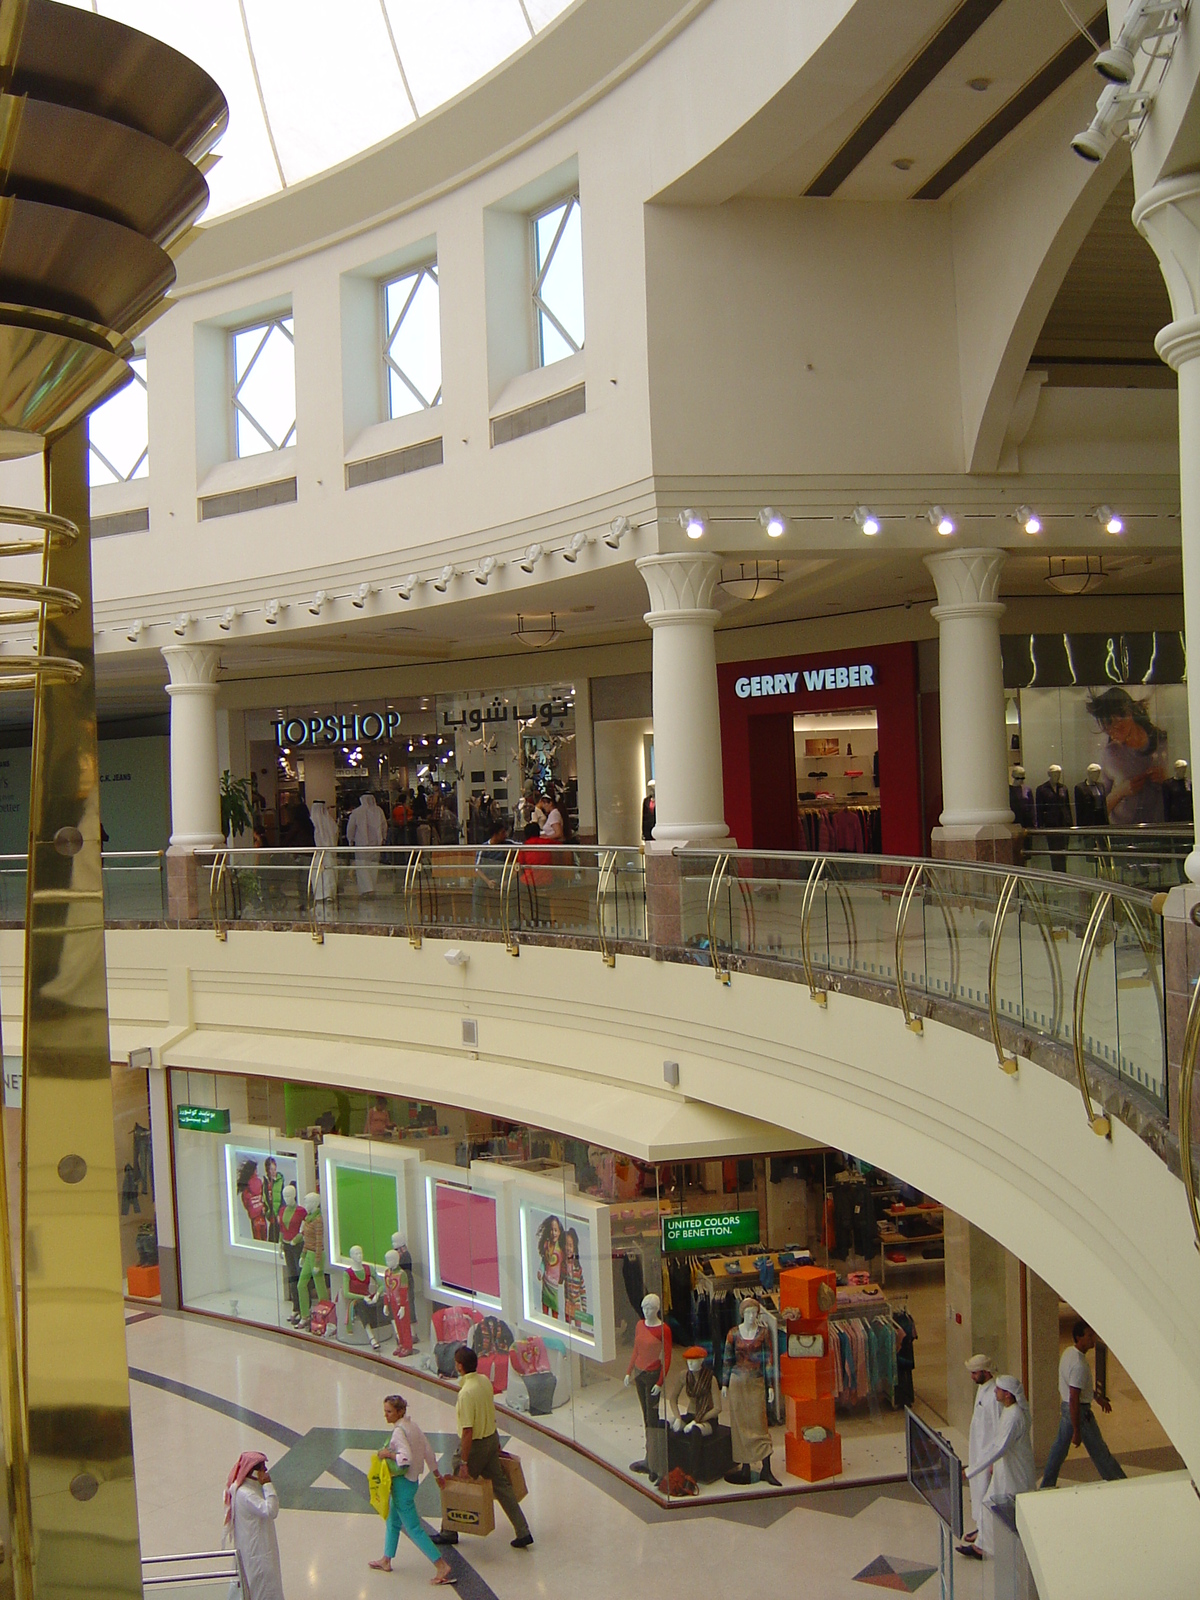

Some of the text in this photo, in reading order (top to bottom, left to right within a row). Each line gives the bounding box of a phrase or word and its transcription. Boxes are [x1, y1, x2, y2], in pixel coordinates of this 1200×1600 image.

[735, 664, 874, 698] GERRY WEBER
[443, 697, 508, 732] شوب
[270, 711, 401, 746] TOPSHOP
[112, 773, 132, 781] JEANS
[4, 1074, 22, 1089] NE
[667, 1216, 740, 1230] UNITED COLORS
[667, 1226, 733, 1239] OF BENETTON.
[451, 1512, 475, 1521] IKEA
